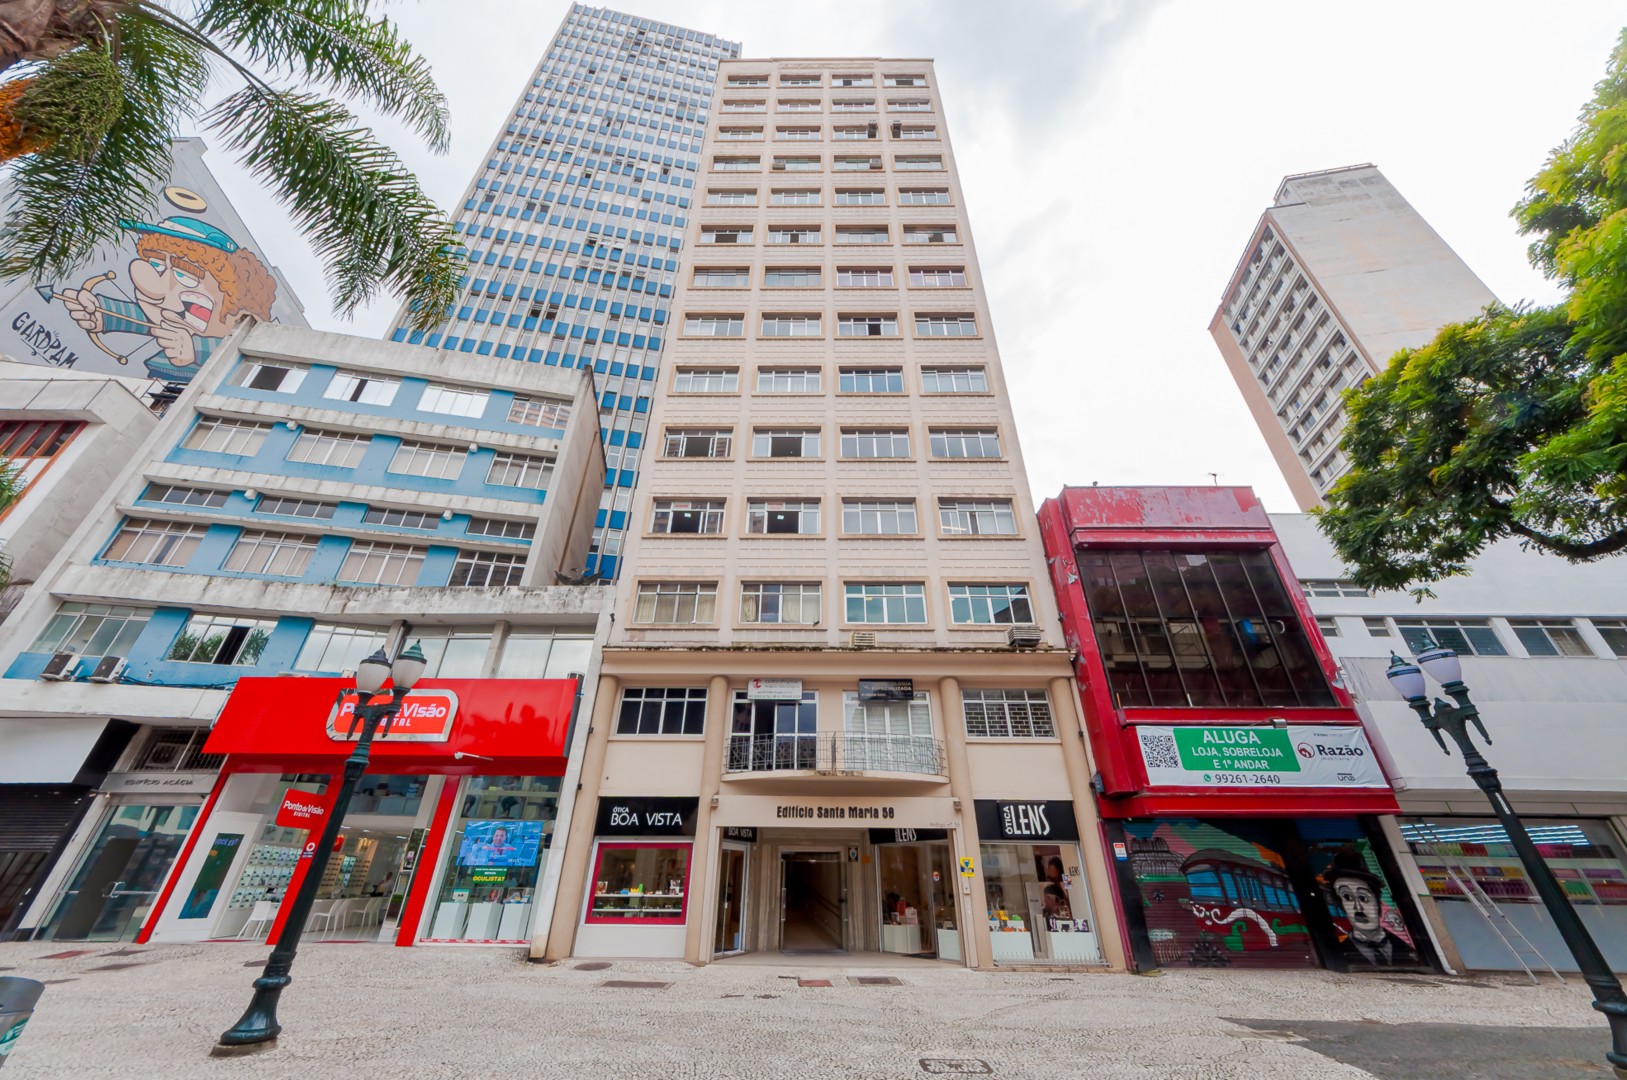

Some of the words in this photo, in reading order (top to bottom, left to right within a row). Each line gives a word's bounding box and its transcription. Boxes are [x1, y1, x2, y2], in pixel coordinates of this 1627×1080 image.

[403, 703, 446, 718] Visão
[1203, 730, 1261, 745] ALUGA
[1192, 747, 1222, 757] LOJA,
[1222, 747, 1283, 757] SOBRELOJA
[1316, 744, 1364, 756] Razão
[1213, 760, 1221, 769] E
[1234, 760, 1270, 769] ANDAR
[1215, 774, 1281, 785] 99261-2640
[610, 812, 639, 826] BOA
[646, 812, 683, 826] VISTA
[777, 805, 814, 819] Edifício
[817, 806, 845, 819] Santa
[849, 806, 879, 819] Maria
[1003, 806, 1013, 835] ÓTICA
[1009, 804, 1050, 836] LENS
[740, 828, 753, 838] VISTA
[897, 828, 917, 842] LENS
